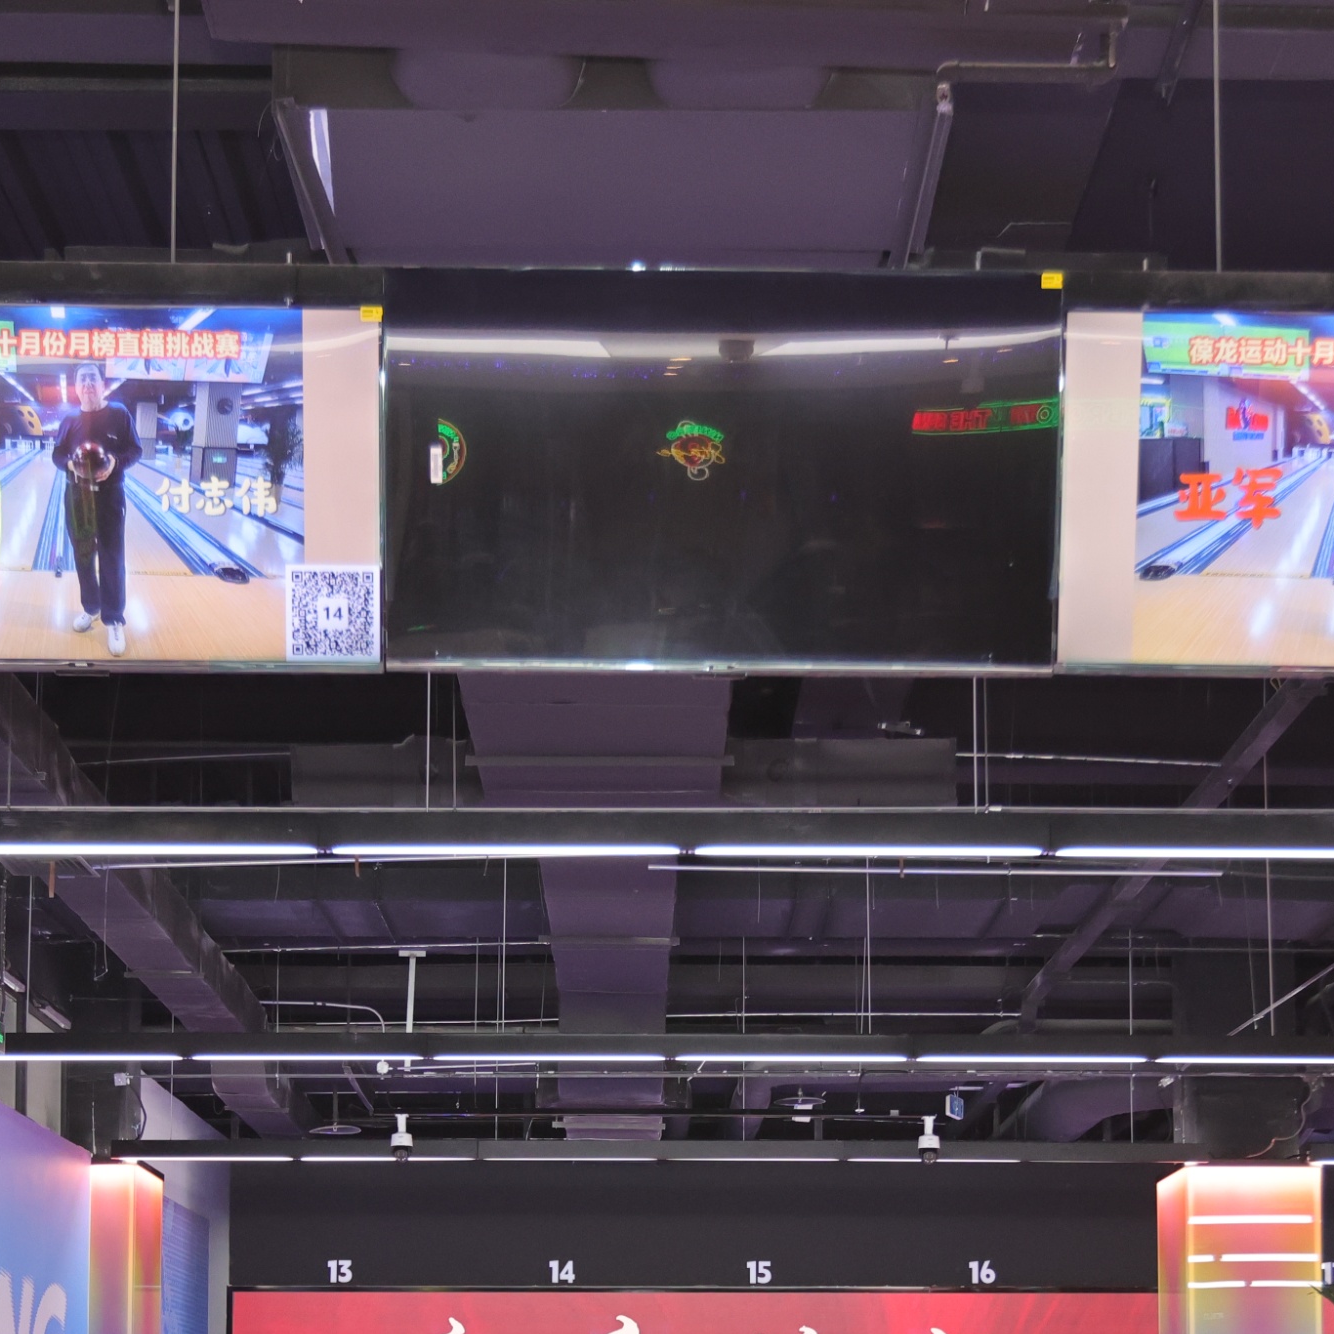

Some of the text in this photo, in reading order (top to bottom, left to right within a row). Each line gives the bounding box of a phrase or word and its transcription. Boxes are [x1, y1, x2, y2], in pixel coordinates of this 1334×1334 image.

[158, 478, 278, 517] 付志伟
[1173, 466, 1283, 529] 亚军
[323, 606, 344, 622] 14
[327, 1259, 352, 1284] 13
[549, 1260, 575, 1284] 14
[746, 1260, 772, 1285] 15
[969, 1260, 996, 1285] 16
